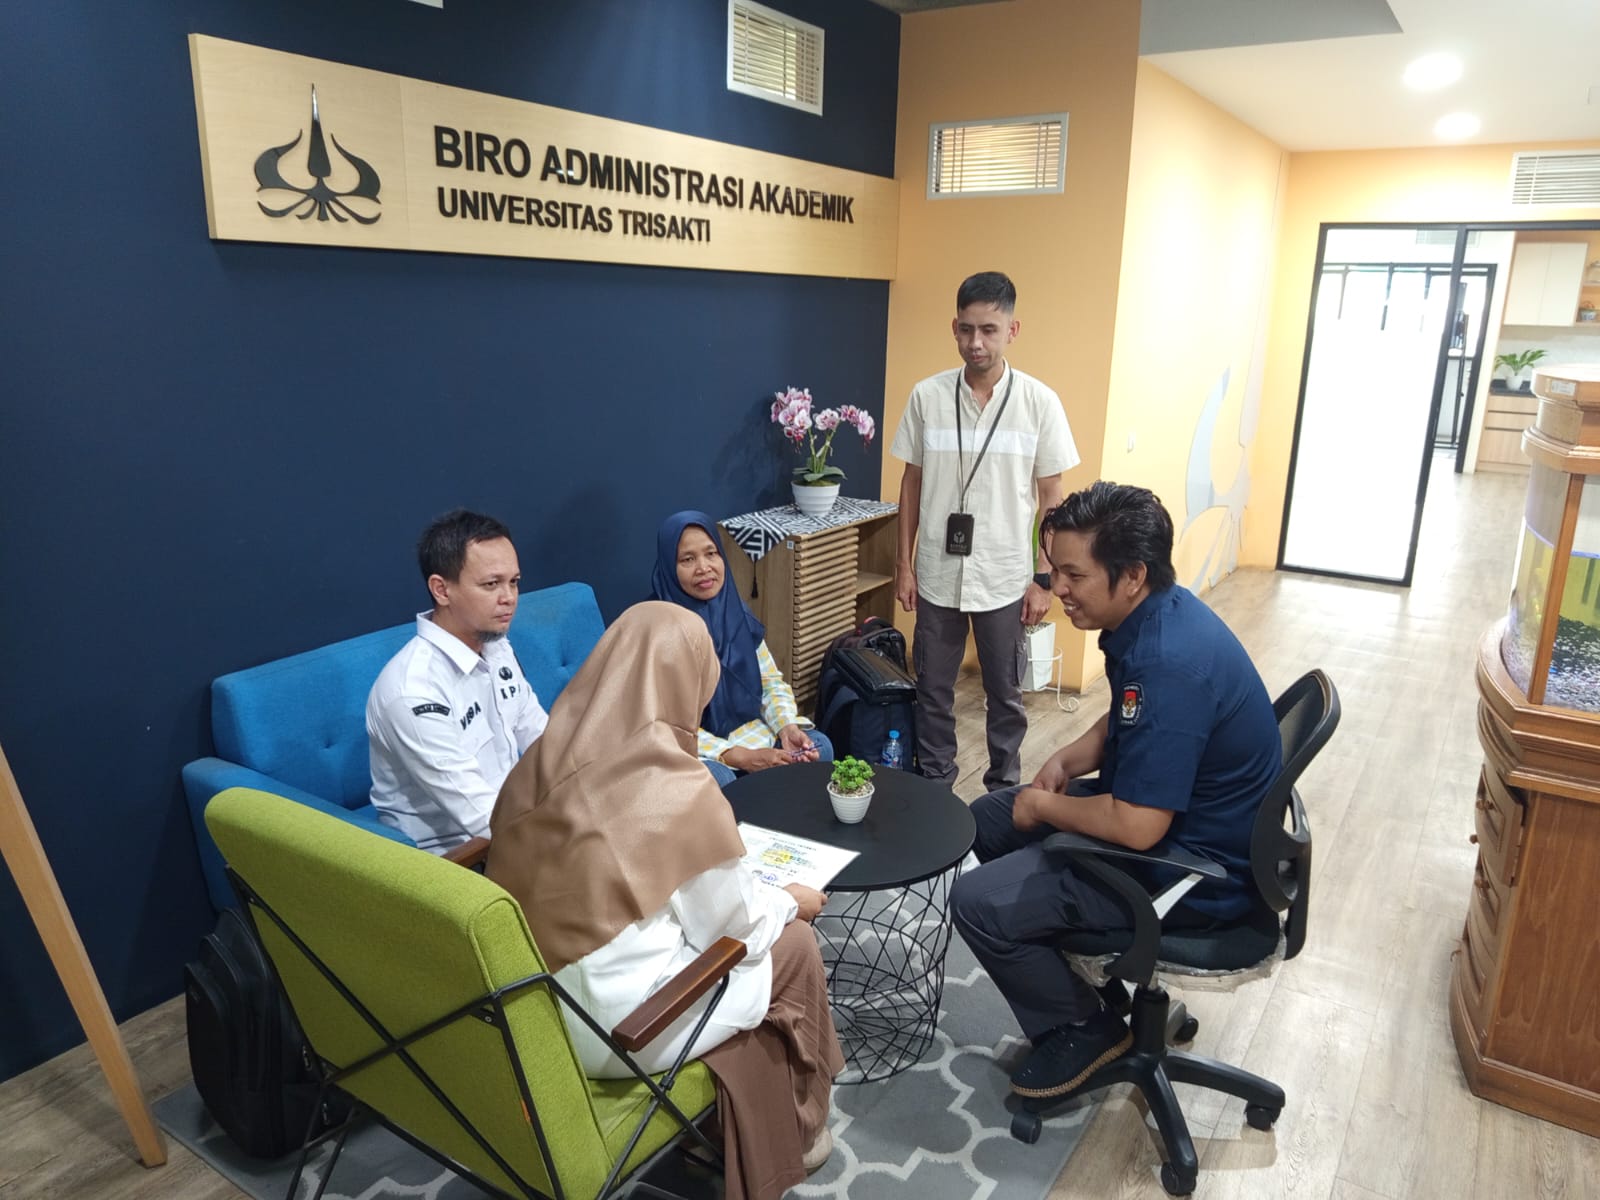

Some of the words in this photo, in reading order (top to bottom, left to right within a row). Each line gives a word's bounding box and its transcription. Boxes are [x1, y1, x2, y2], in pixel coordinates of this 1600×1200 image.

[434, 125, 531, 178] BIRO
[540, 145, 744, 209] ADMINISTRASI
[750, 181, 855, 224] AKADEMIK
[437, 186, 613, 233] UNIVERSITAS
[619, 208, 711, 242] TRISAKTI
